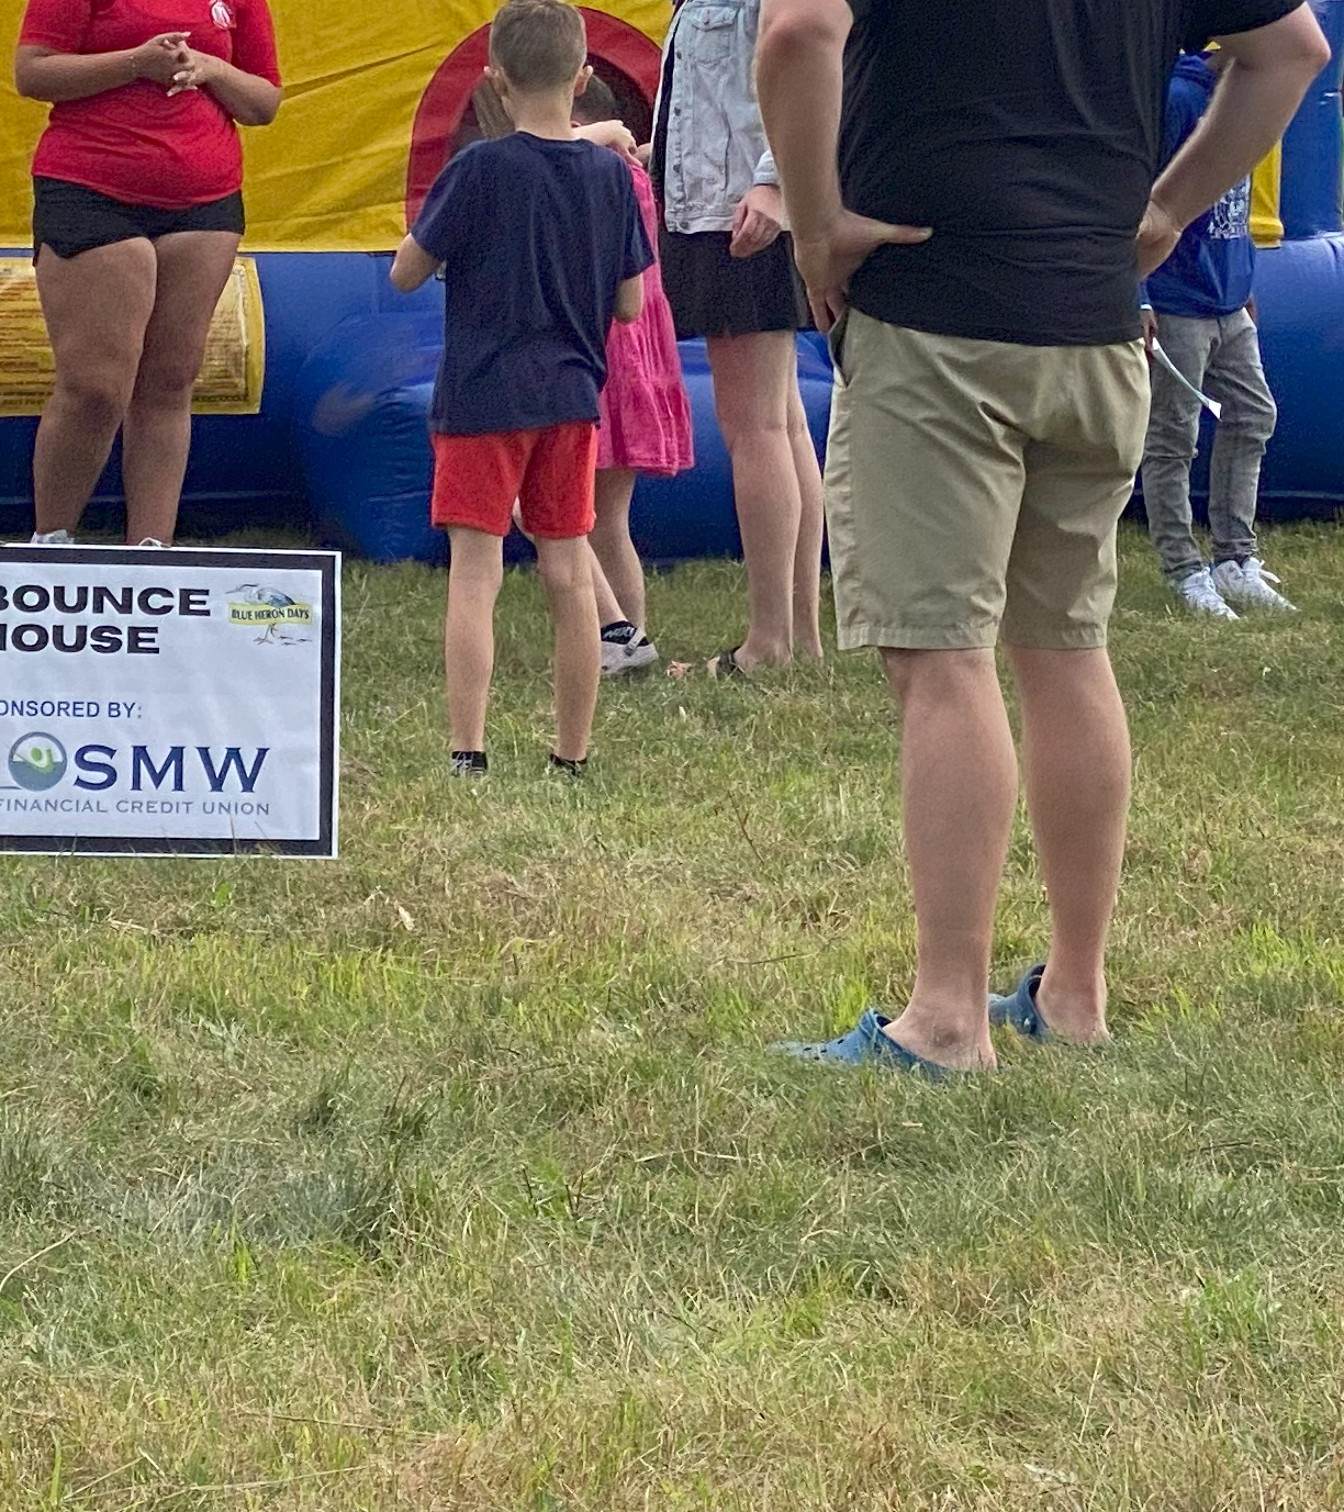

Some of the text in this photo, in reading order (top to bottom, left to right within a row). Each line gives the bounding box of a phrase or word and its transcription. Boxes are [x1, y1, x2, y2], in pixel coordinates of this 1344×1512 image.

[231, 608, 310, 620] BLUE HERON DAYS
[108, 702, 143, 719] BY:
[73, 744, 270, 793] SMW
[116, 800, 193, 815] CREDIT
[202, 802, 270, 816] UNION
